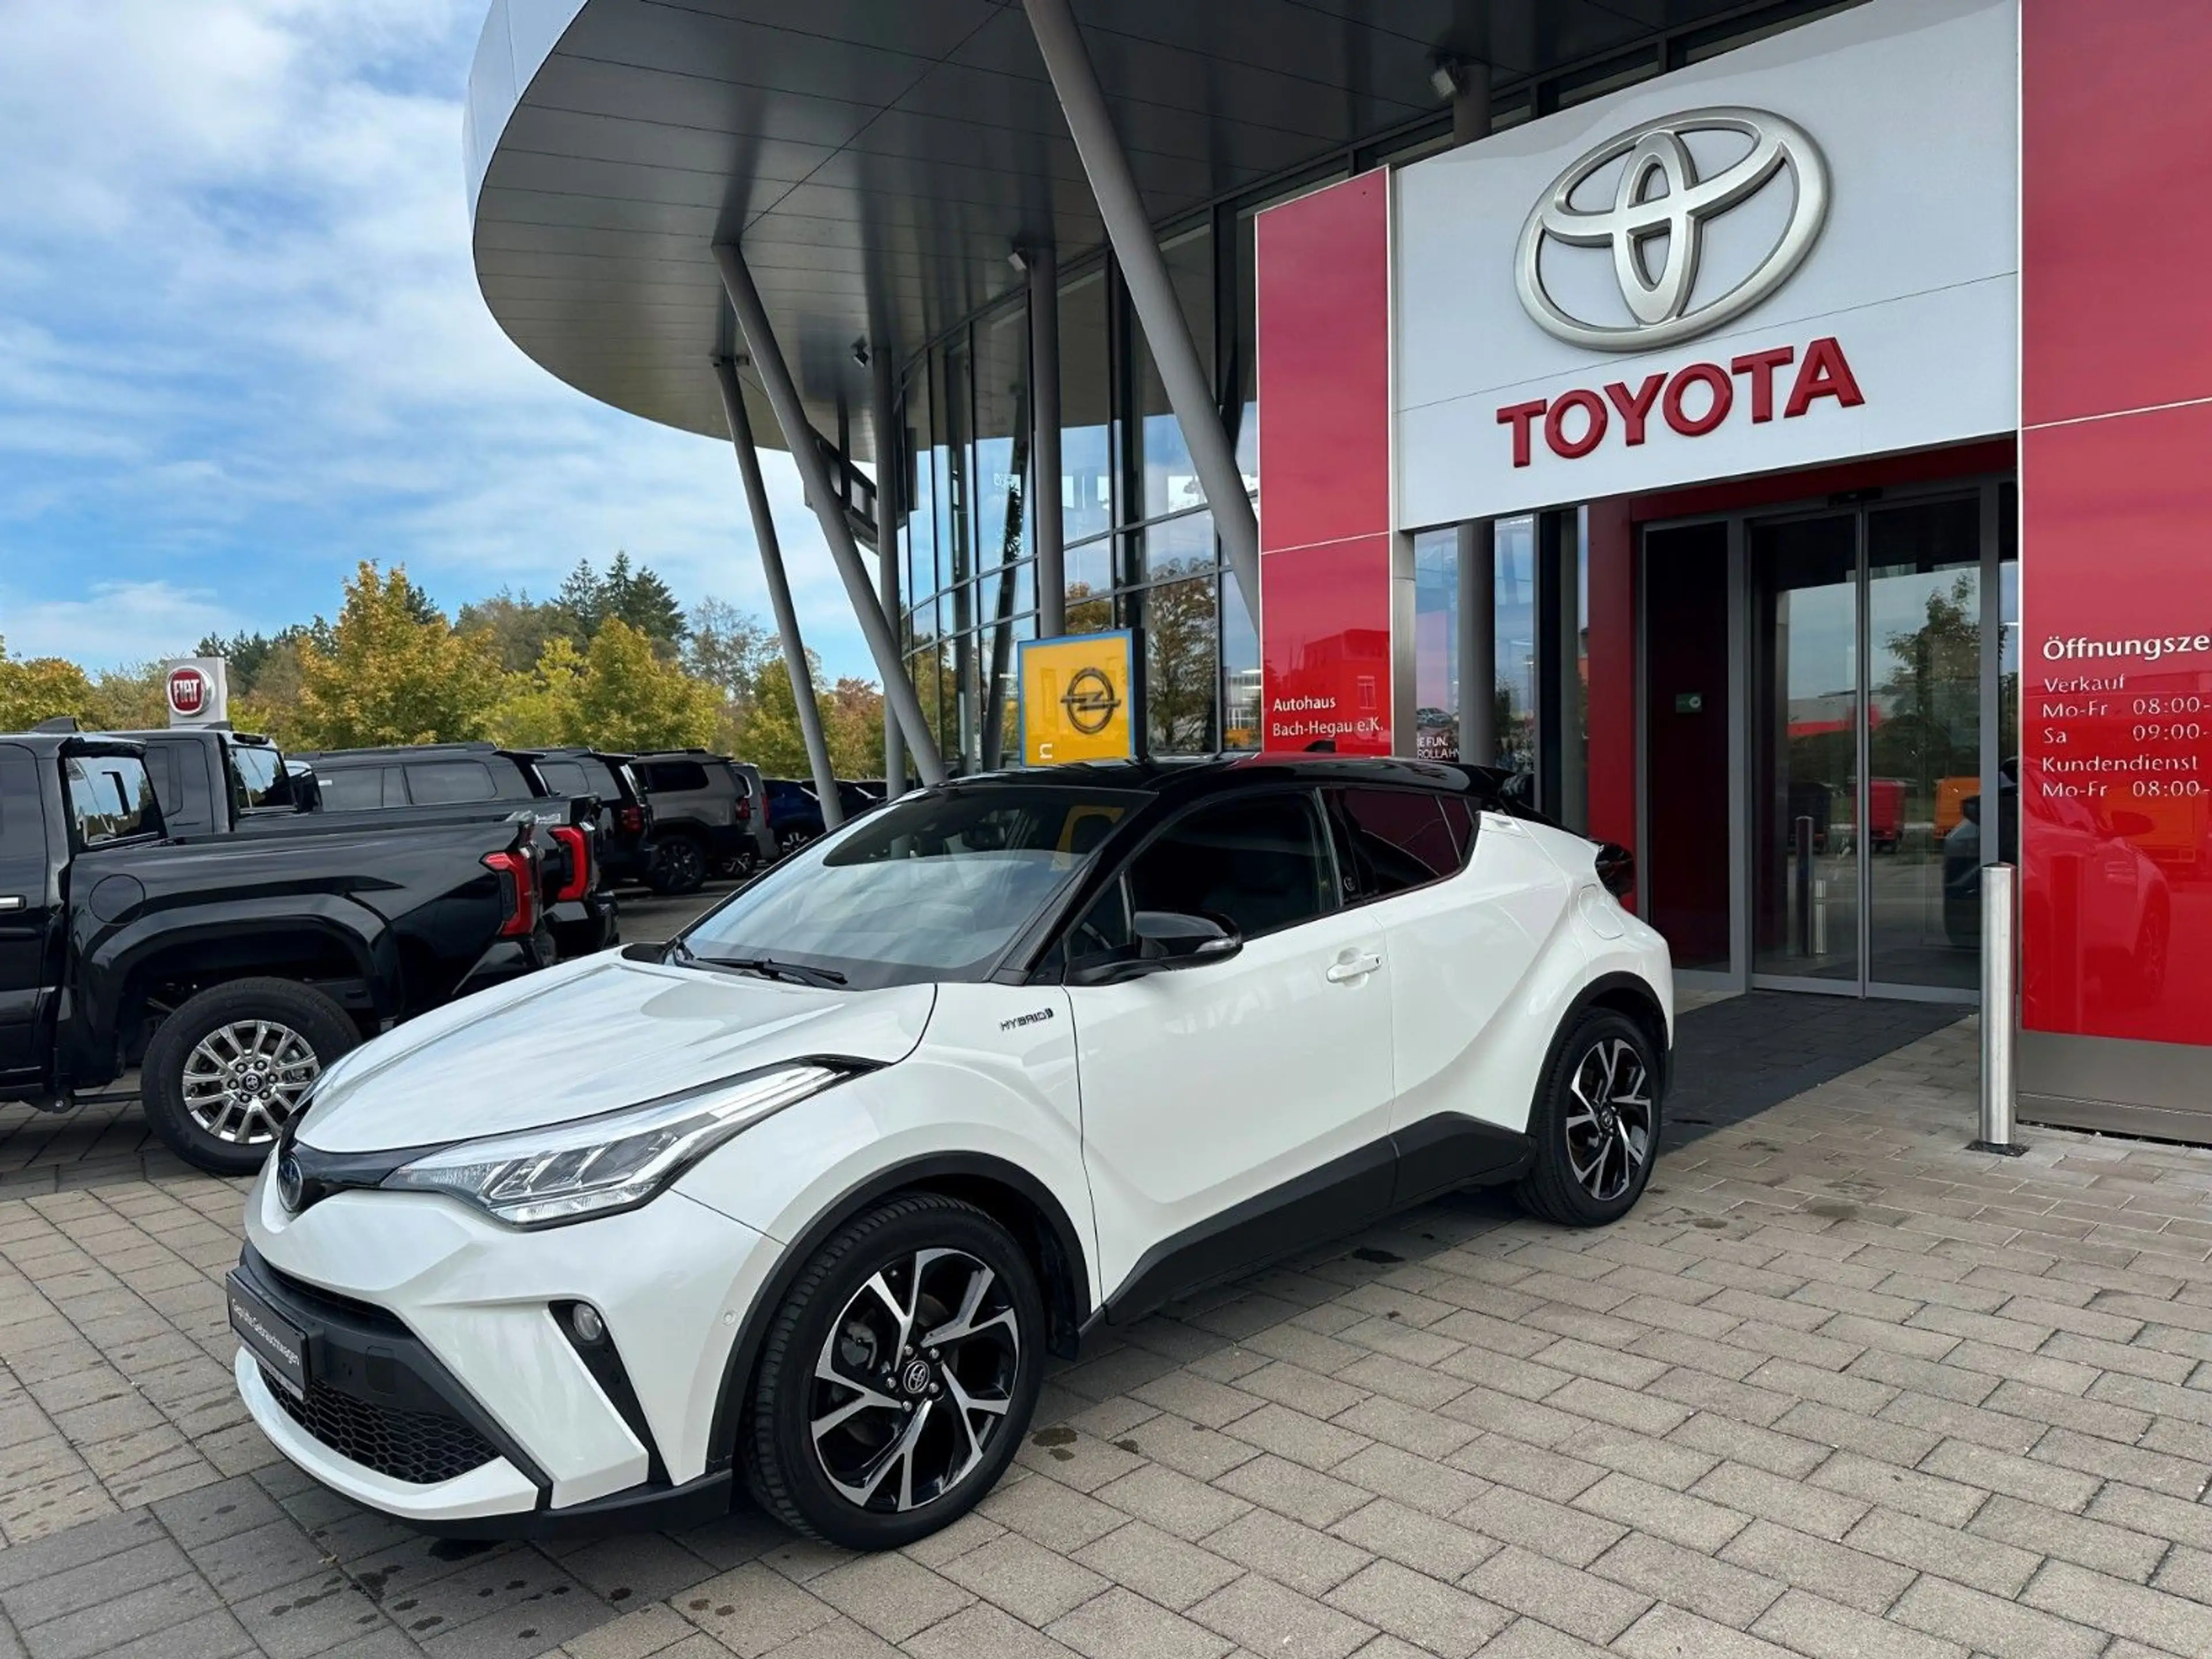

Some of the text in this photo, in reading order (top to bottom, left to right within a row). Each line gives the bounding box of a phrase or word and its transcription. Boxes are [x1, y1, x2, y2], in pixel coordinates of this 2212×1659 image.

[1497, 336, 1866, 468] TOYOTA
[2043, 635, 2210, 661] Öffnungsze
[173, 679, 200, 704] FIAT
[2044, 673, 2126, 693] Verkauf
[1273, 695, 1336, 712] Autohaus
[2043, 699, 2108, 718] Mo-Fr
[1272, 716, 1384, 737] Bach-Hegau e.K.
[2044, 727, 2067, 744] Sa
[2042, 753, 2198, 772] Kundendienst
[2043, 781, 2108, 797] Mo-Fr
[1000, 1010, 1047, 1031] HYBRID
